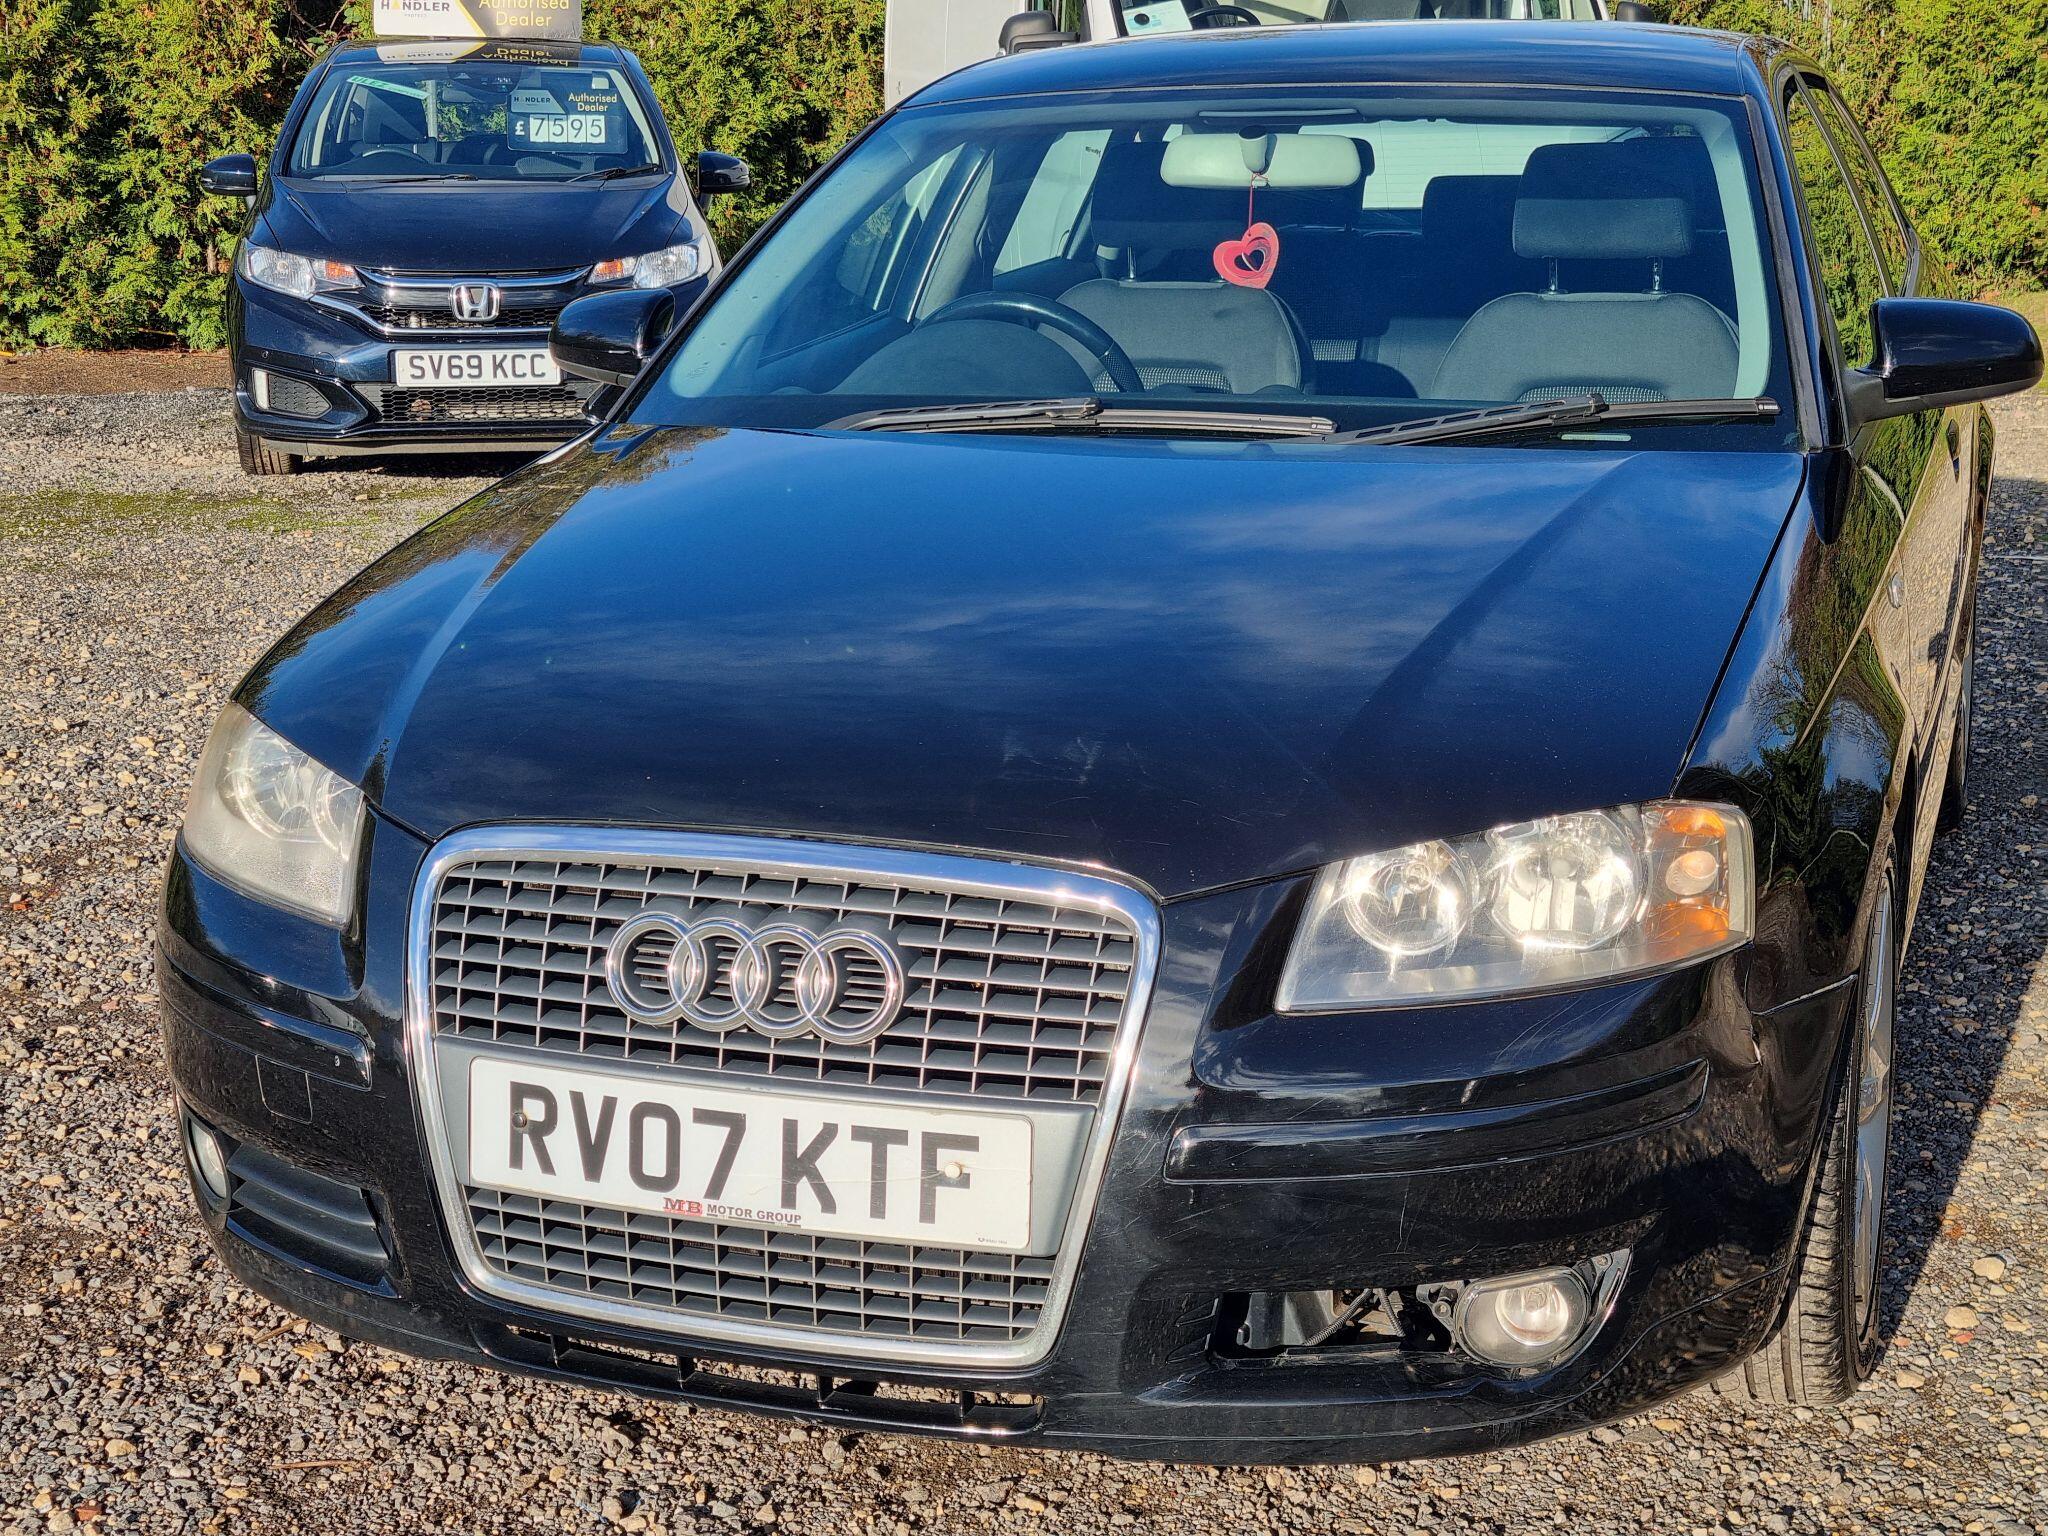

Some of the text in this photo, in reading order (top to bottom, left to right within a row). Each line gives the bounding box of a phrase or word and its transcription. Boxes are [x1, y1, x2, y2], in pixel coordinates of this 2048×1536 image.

[496, 11, 552, 28] Dealer
[568, 92, 617, 103] Authorised
[577, 102, 608, 112] Dealer
[409, 354, 546, 379] SV69 KCC
[508, 1080, 980, 1224] RV07 KTF
[663, 1197, 801, 1224] MB MOTOR GROUP
